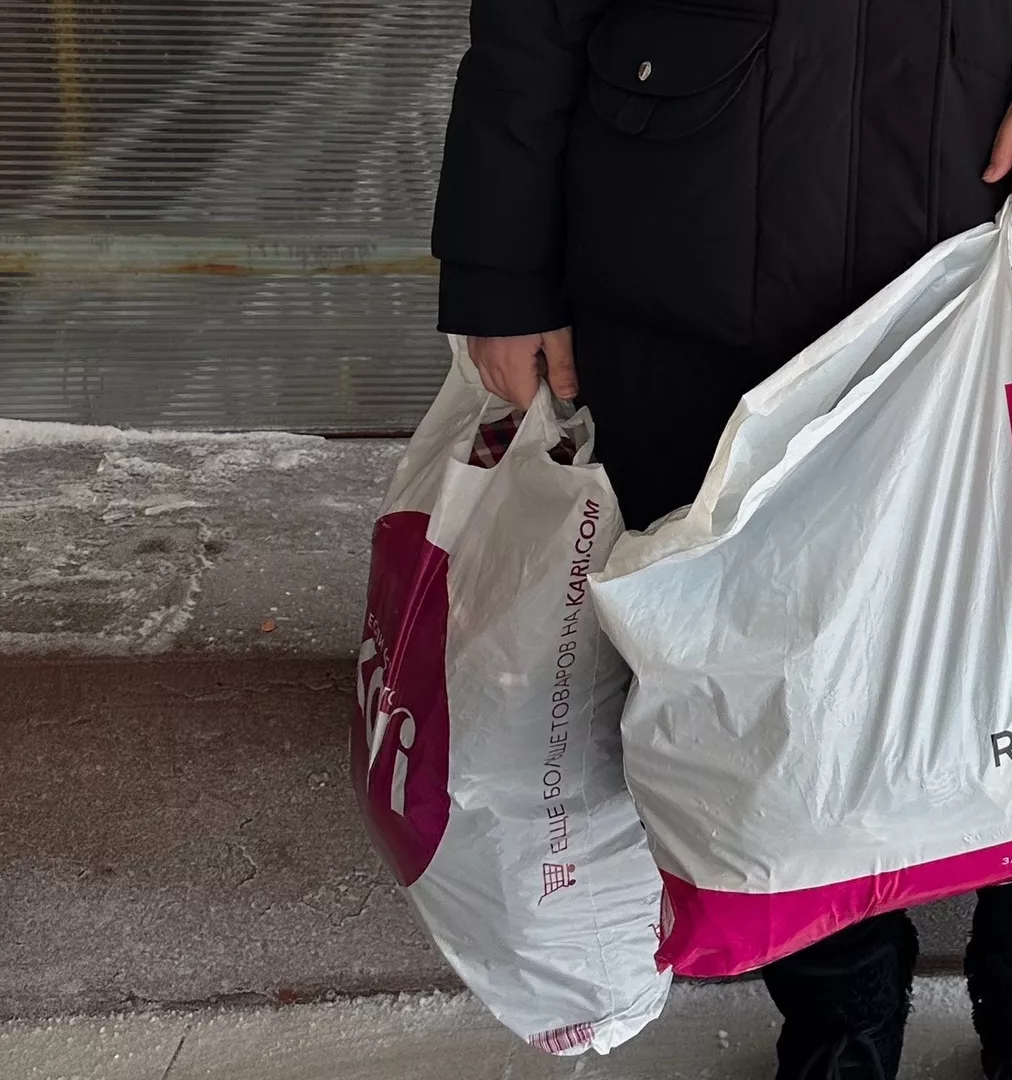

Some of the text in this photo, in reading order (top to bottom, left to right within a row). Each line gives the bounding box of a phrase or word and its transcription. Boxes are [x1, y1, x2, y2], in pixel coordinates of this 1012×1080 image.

[565, 498, 599, 607] KARI.COM
[561, 609, 580, 637] НА
[547, 803, 569, 854] ЕЩЕ
